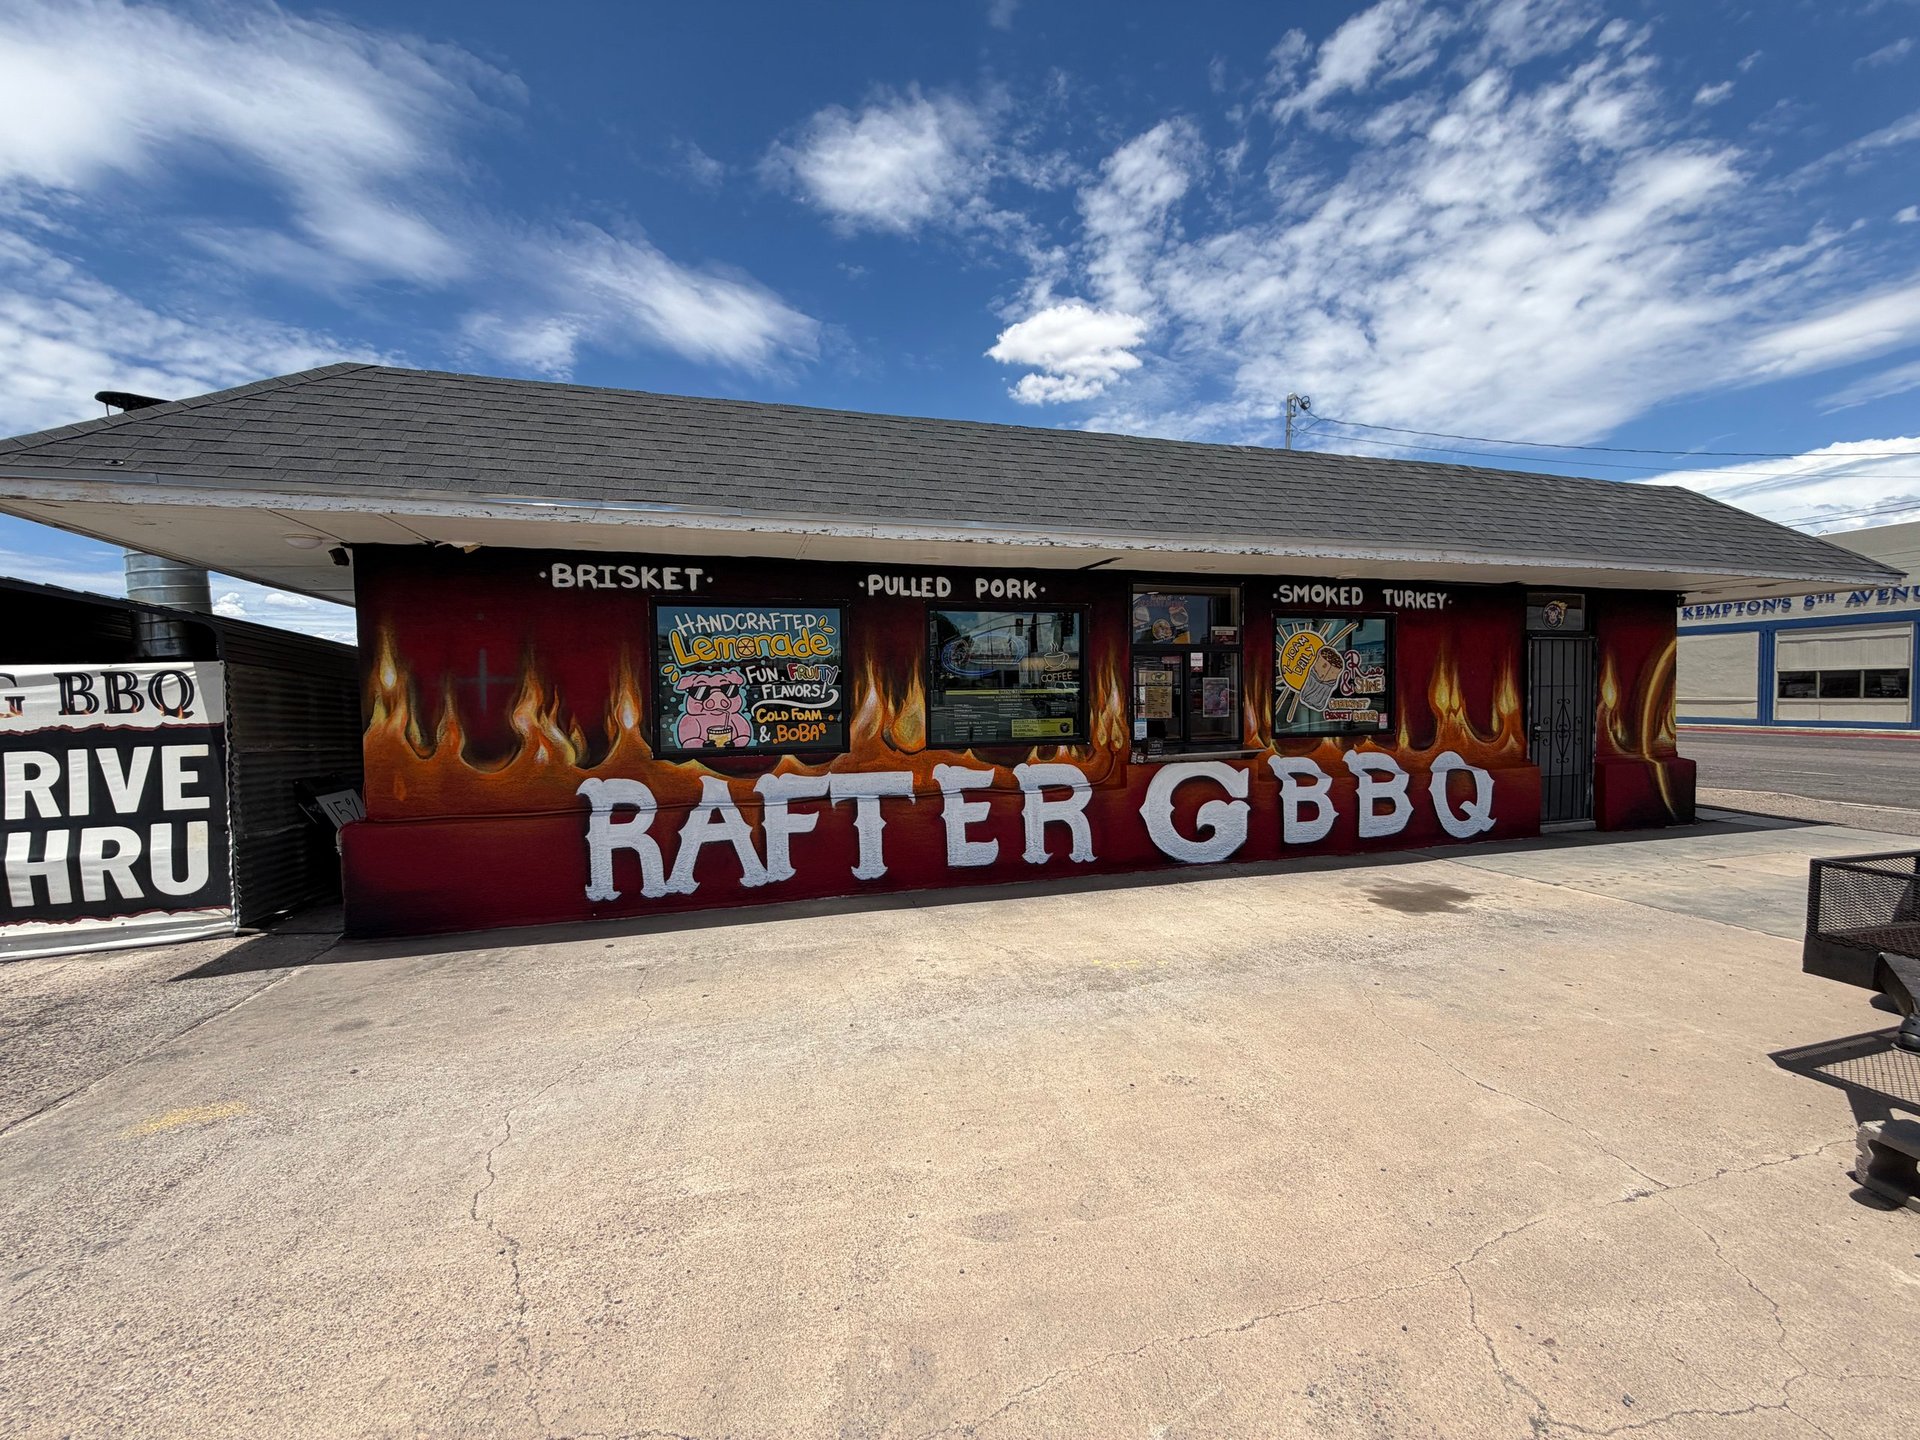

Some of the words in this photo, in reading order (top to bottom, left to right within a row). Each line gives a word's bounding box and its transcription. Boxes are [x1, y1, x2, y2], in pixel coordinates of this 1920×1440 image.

[551, 563, 703, 591] BRISKET
[868, 574, 951, 598] PULLED
[975, 577, 1037, 599] PORK
[1279, 584, 1363, 607] SMOKED
[1382, 589, 1447, 609] TURKEY
[1681, 596, 1791, 620] KEMPTON'S
[1803, 592, 1835, 611] 8TH
[674, 612, 817, 637] HANDCRAFTED
[670, 627, 834, 666] Lemonade
[1283, 635, 1309, 674] 7-10AM
[1293, 643, 1315, 676] DAILY
[787, 663, 838, 685] FRUITY
[1040, 672, 1073, 683] COFFEE
[1344, 650, 1384, 678] Rise
[54, 669, 195, 720] BBQ
[761, 682, 827, 699] FLAVORS!
[1341, 671, 1354, 695] &
[756, 708, 789, 723] COLD
[791, 707, 822, 721] FOAM
[759, 725, 771, 743] &
[776, 723, 820, 743] BOBA
[3, 744, 211, 821] RIVE
[577, 763, 1094, 903] RAFTER
[1139, 761, 1251, 863] G
[1268, 749, 1497, 845] BBQ
[5, 820, 209, 908] HRU
